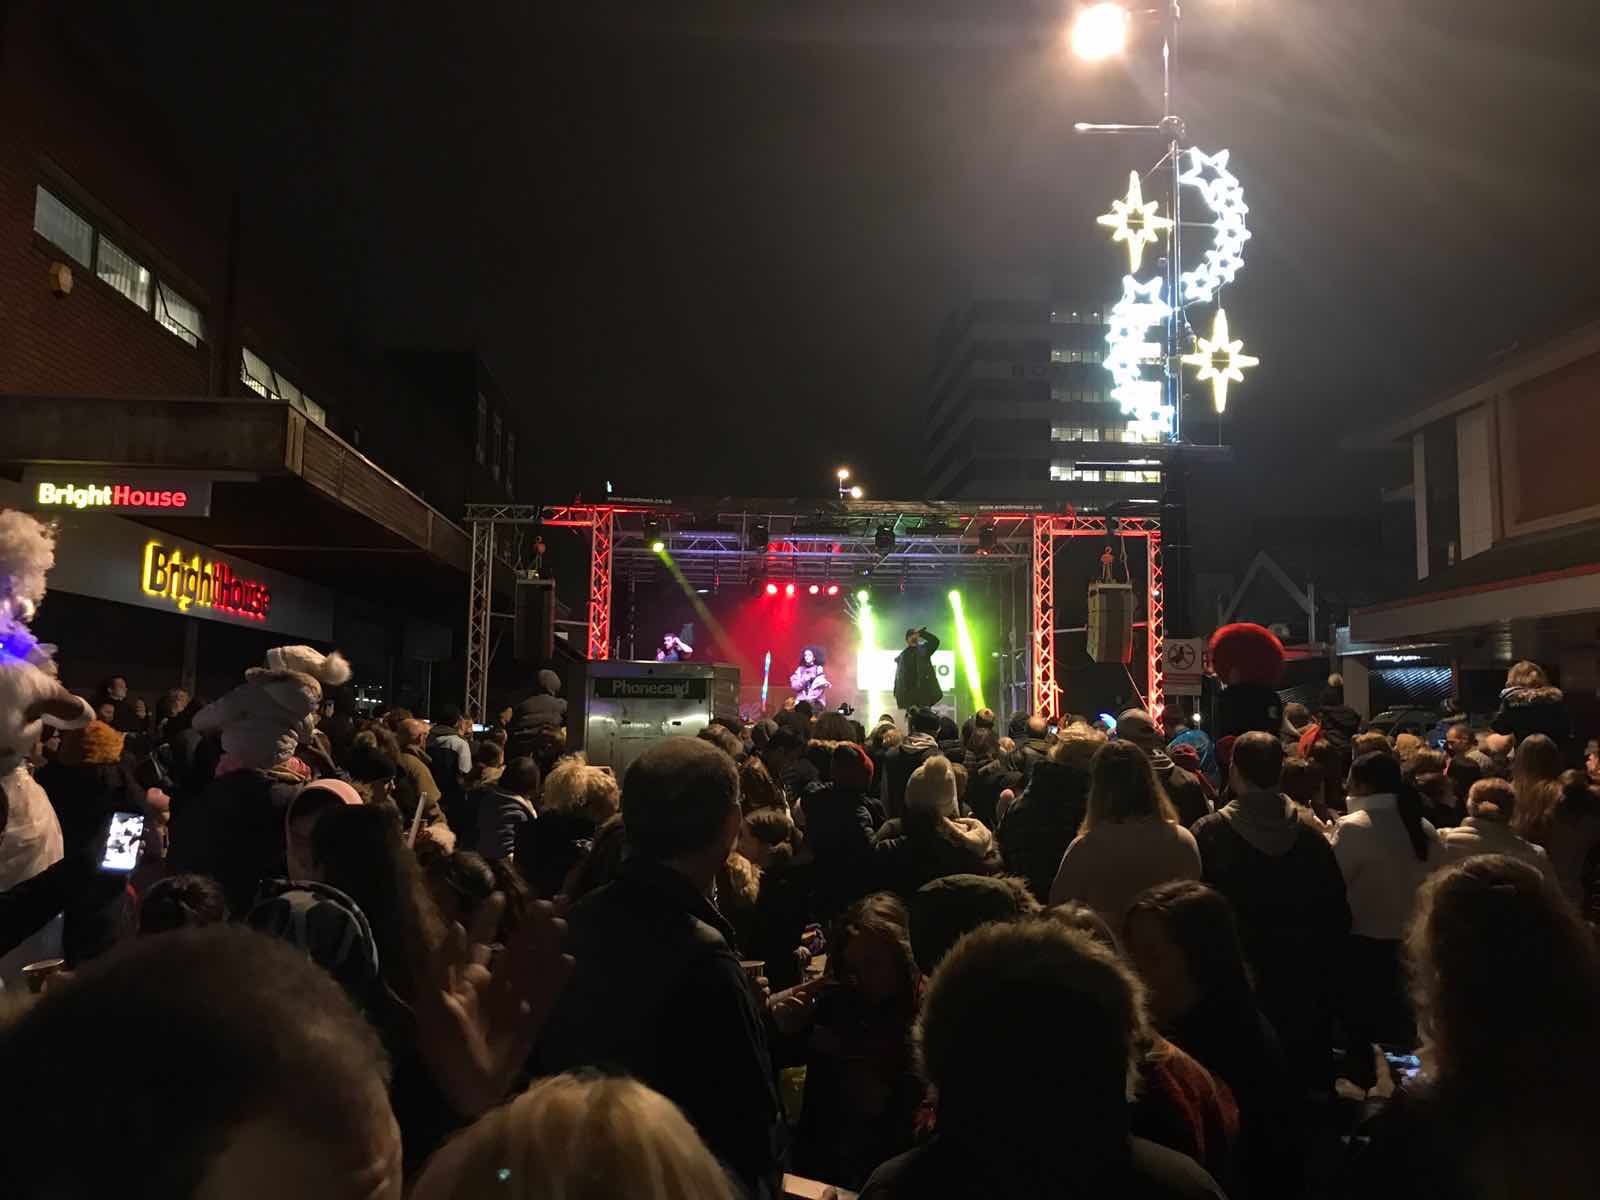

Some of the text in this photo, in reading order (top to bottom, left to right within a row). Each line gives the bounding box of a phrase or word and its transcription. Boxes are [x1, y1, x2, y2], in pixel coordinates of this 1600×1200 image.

[38, 482, 188, 509] BrightHouse
[142, 540, 272, 621] BrightHouse
[611, 679, 690, 696] Phonecard
